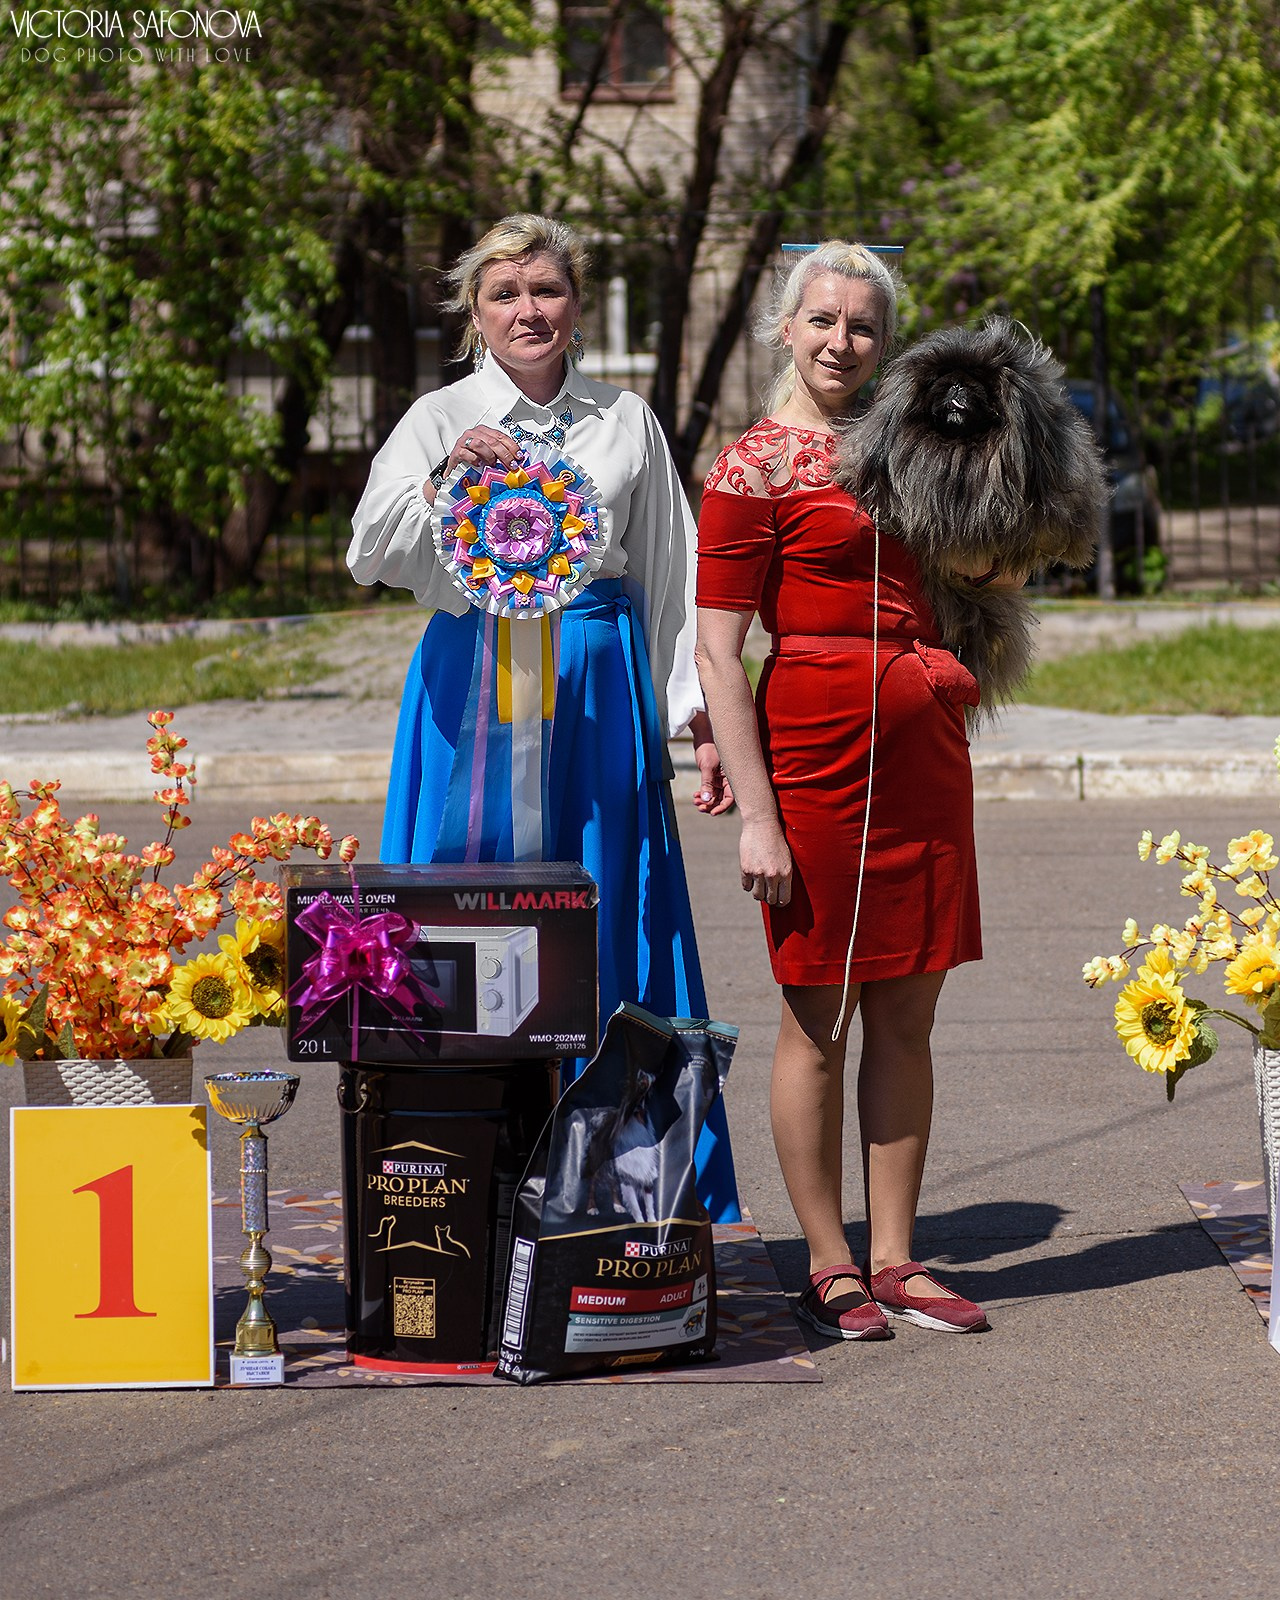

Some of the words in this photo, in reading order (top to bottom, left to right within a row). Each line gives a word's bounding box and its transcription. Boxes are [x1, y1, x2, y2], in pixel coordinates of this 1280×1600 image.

[366, 894, 396, 904] OVEN
[454, 891, 589, 910] WILLMARK
[529, 1034, 586, 1043] WMO-202MW
[298, 1040, 318, 1054] 20
[322, 1040, 332, 1054] L
[555, 1043, 586, 1051] 2001126
[394, 1163, 442, 1174] PURINA
[367, 1174, 404, 1192] PRO
[407, 1178, 467, 1194] PLAN
[384, 1195, 446, 1208] BREEDERS
[72, 1165, 157, 1318] 1
[641, 1241, 687, 1256] PURINA
[595, 1258, 651, 1278] PRO
[655, 1252, 702, 1278] PLAN
[577, 1295, 626, 1306] MEDIUM
[660, 1290, 688, 1304] ADULT
[575, 1317, 618, 1325] SENSITIVE
[620, 1315, 661, 1325] DIGESTION
